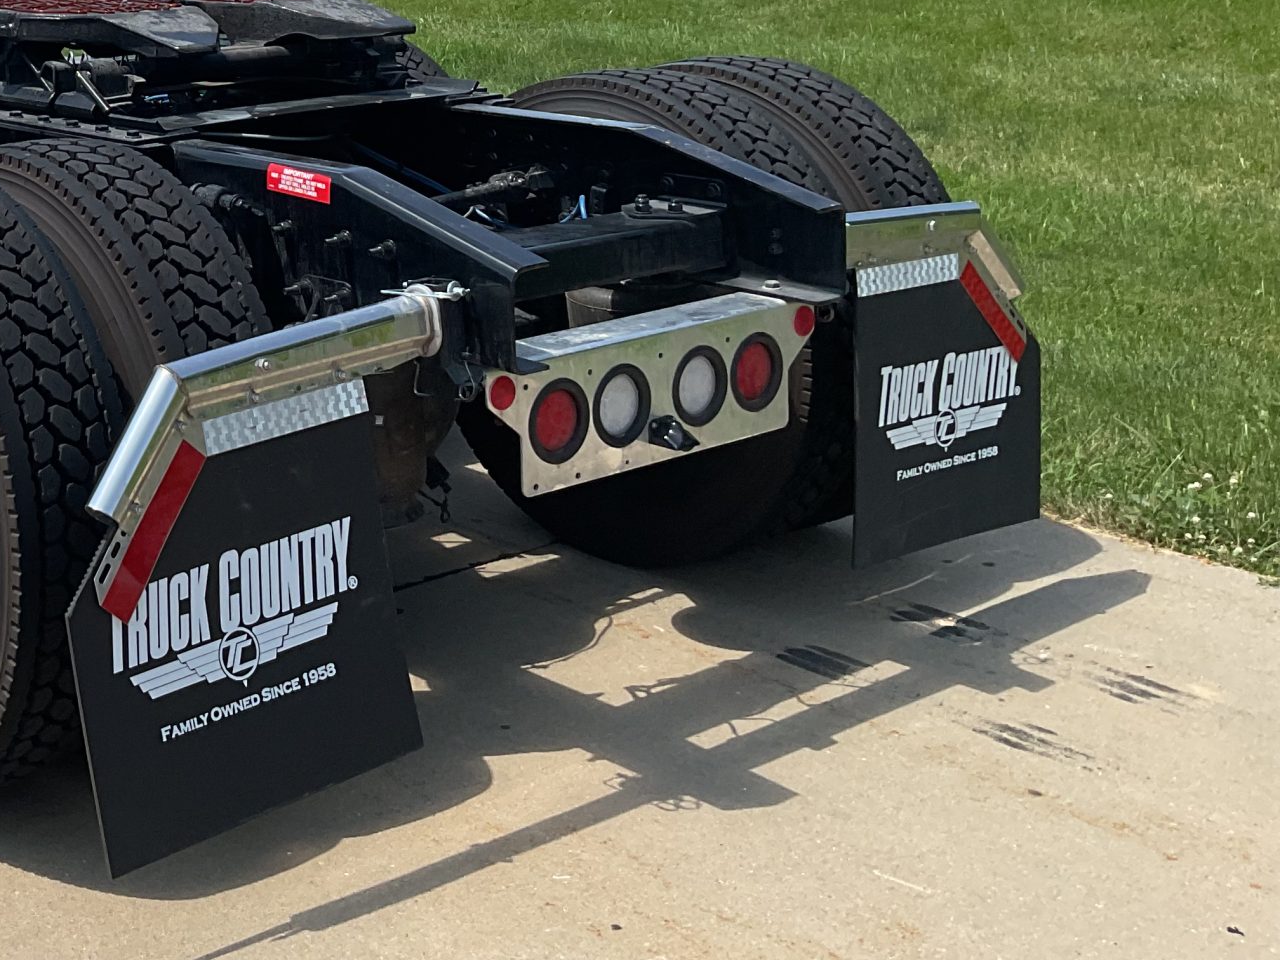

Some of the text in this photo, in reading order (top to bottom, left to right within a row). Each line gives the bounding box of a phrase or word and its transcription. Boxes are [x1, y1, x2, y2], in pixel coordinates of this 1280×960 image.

[878, 360, 939, 428] TRUCK
[896, 445, 999, 481] FAMILY OWNED SINCE 1958
[219, 515, 351, 634] COUNTRY
[160, 662, 337, 742] FAMILY OWNED SINCE 1958
